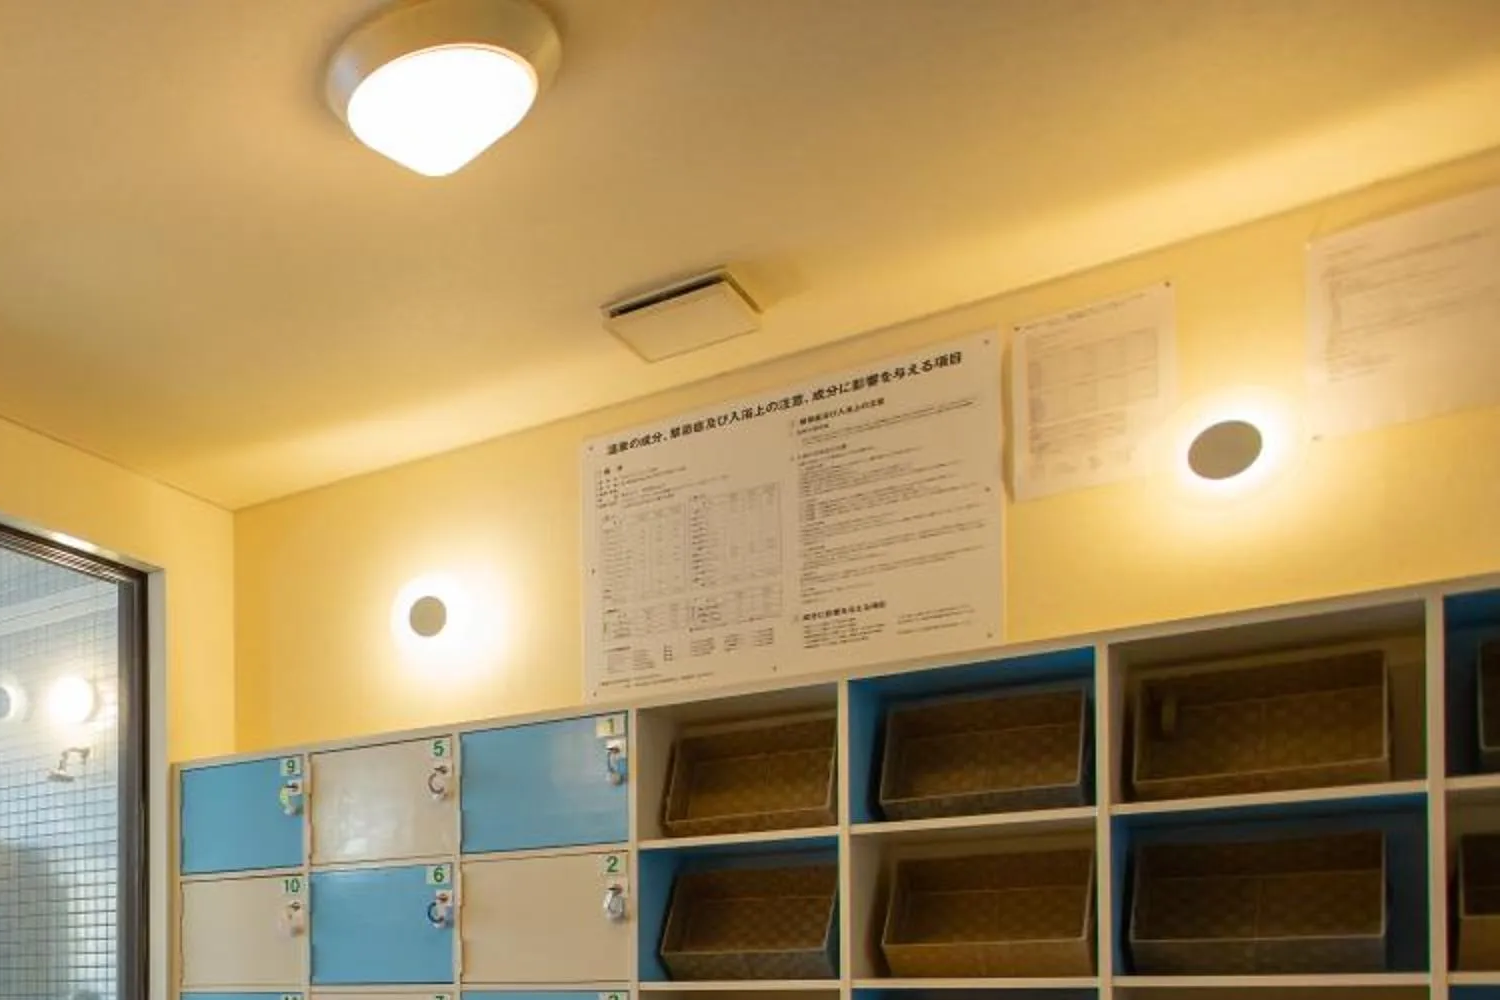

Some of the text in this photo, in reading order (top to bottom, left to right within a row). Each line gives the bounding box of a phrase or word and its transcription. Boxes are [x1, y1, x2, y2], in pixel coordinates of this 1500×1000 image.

[608, 718, 615, 735] 1
[433, 740, 444, 757] 5
[286, 759, 296, 773] 9
[606, 856, 619, 873] 2
[434, 865, 445, 883] 6
[284, 878, 300, 893] 10
